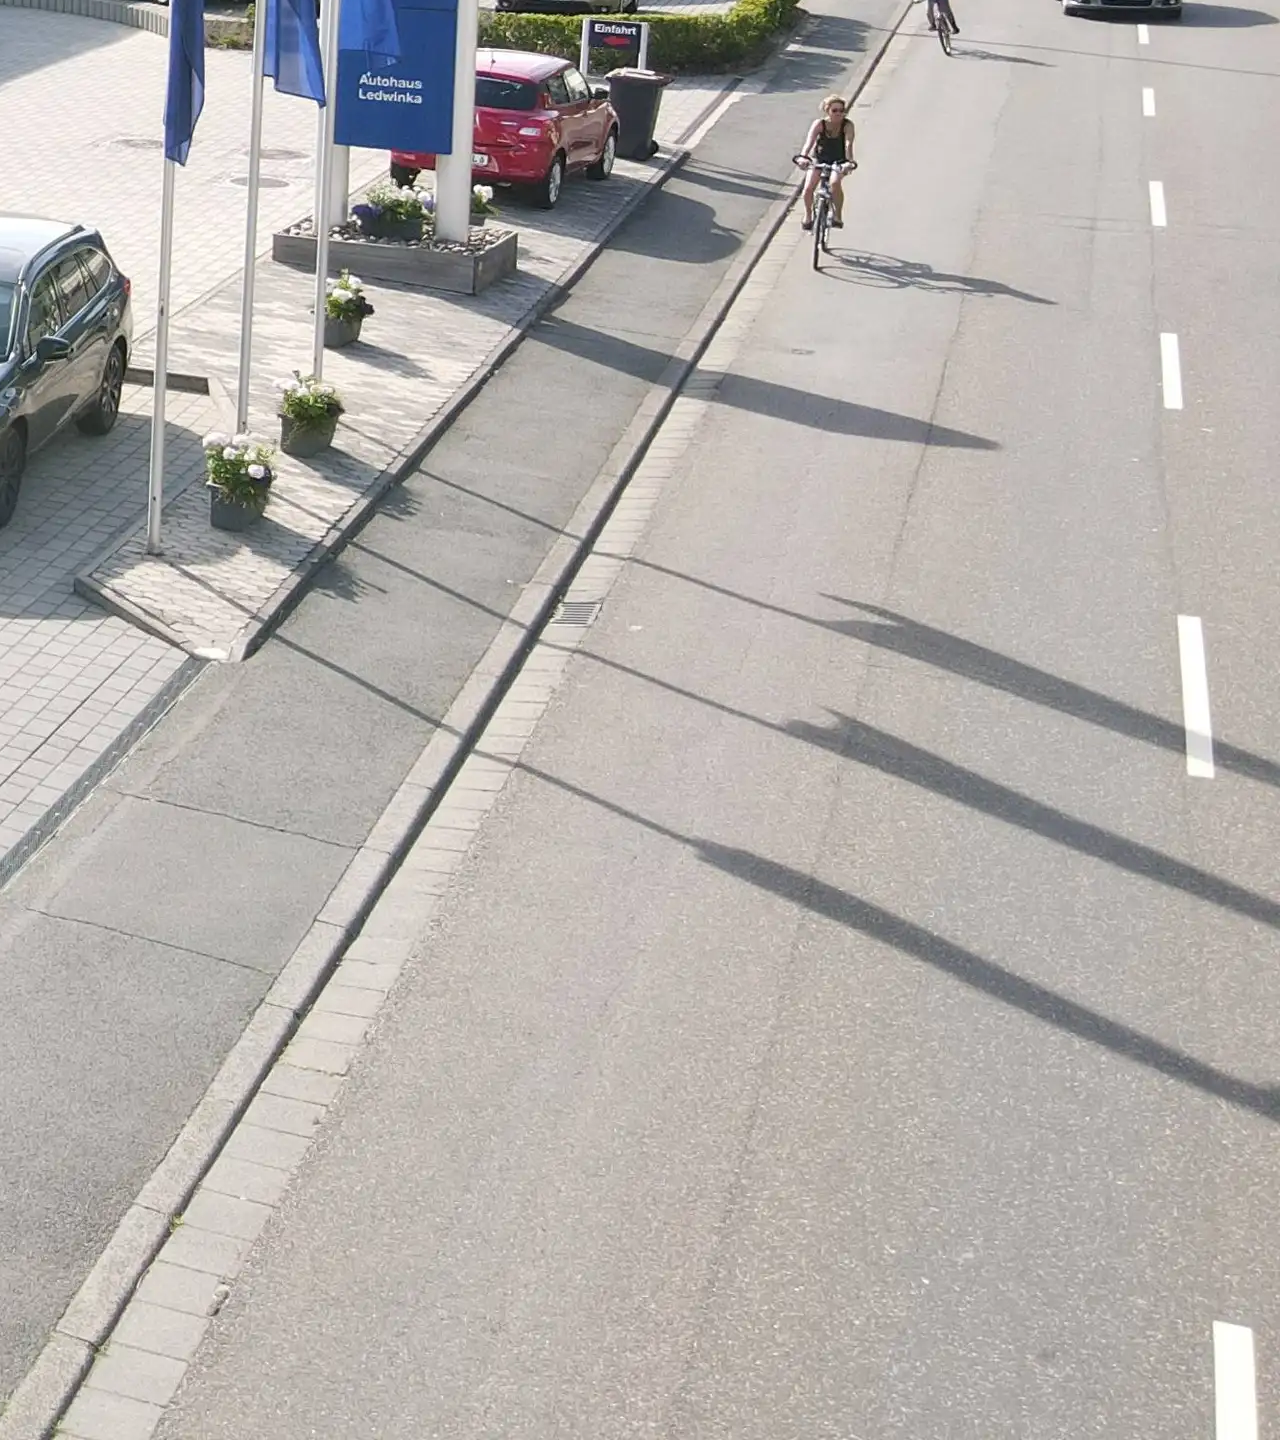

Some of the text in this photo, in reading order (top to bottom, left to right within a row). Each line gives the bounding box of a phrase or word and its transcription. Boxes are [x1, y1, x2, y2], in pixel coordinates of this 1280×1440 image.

[594, 23, 637, 36] Einfahrt
[358, 72, 423, 90] Autohaus
[358, 87, 423, 105] Ledwinka
